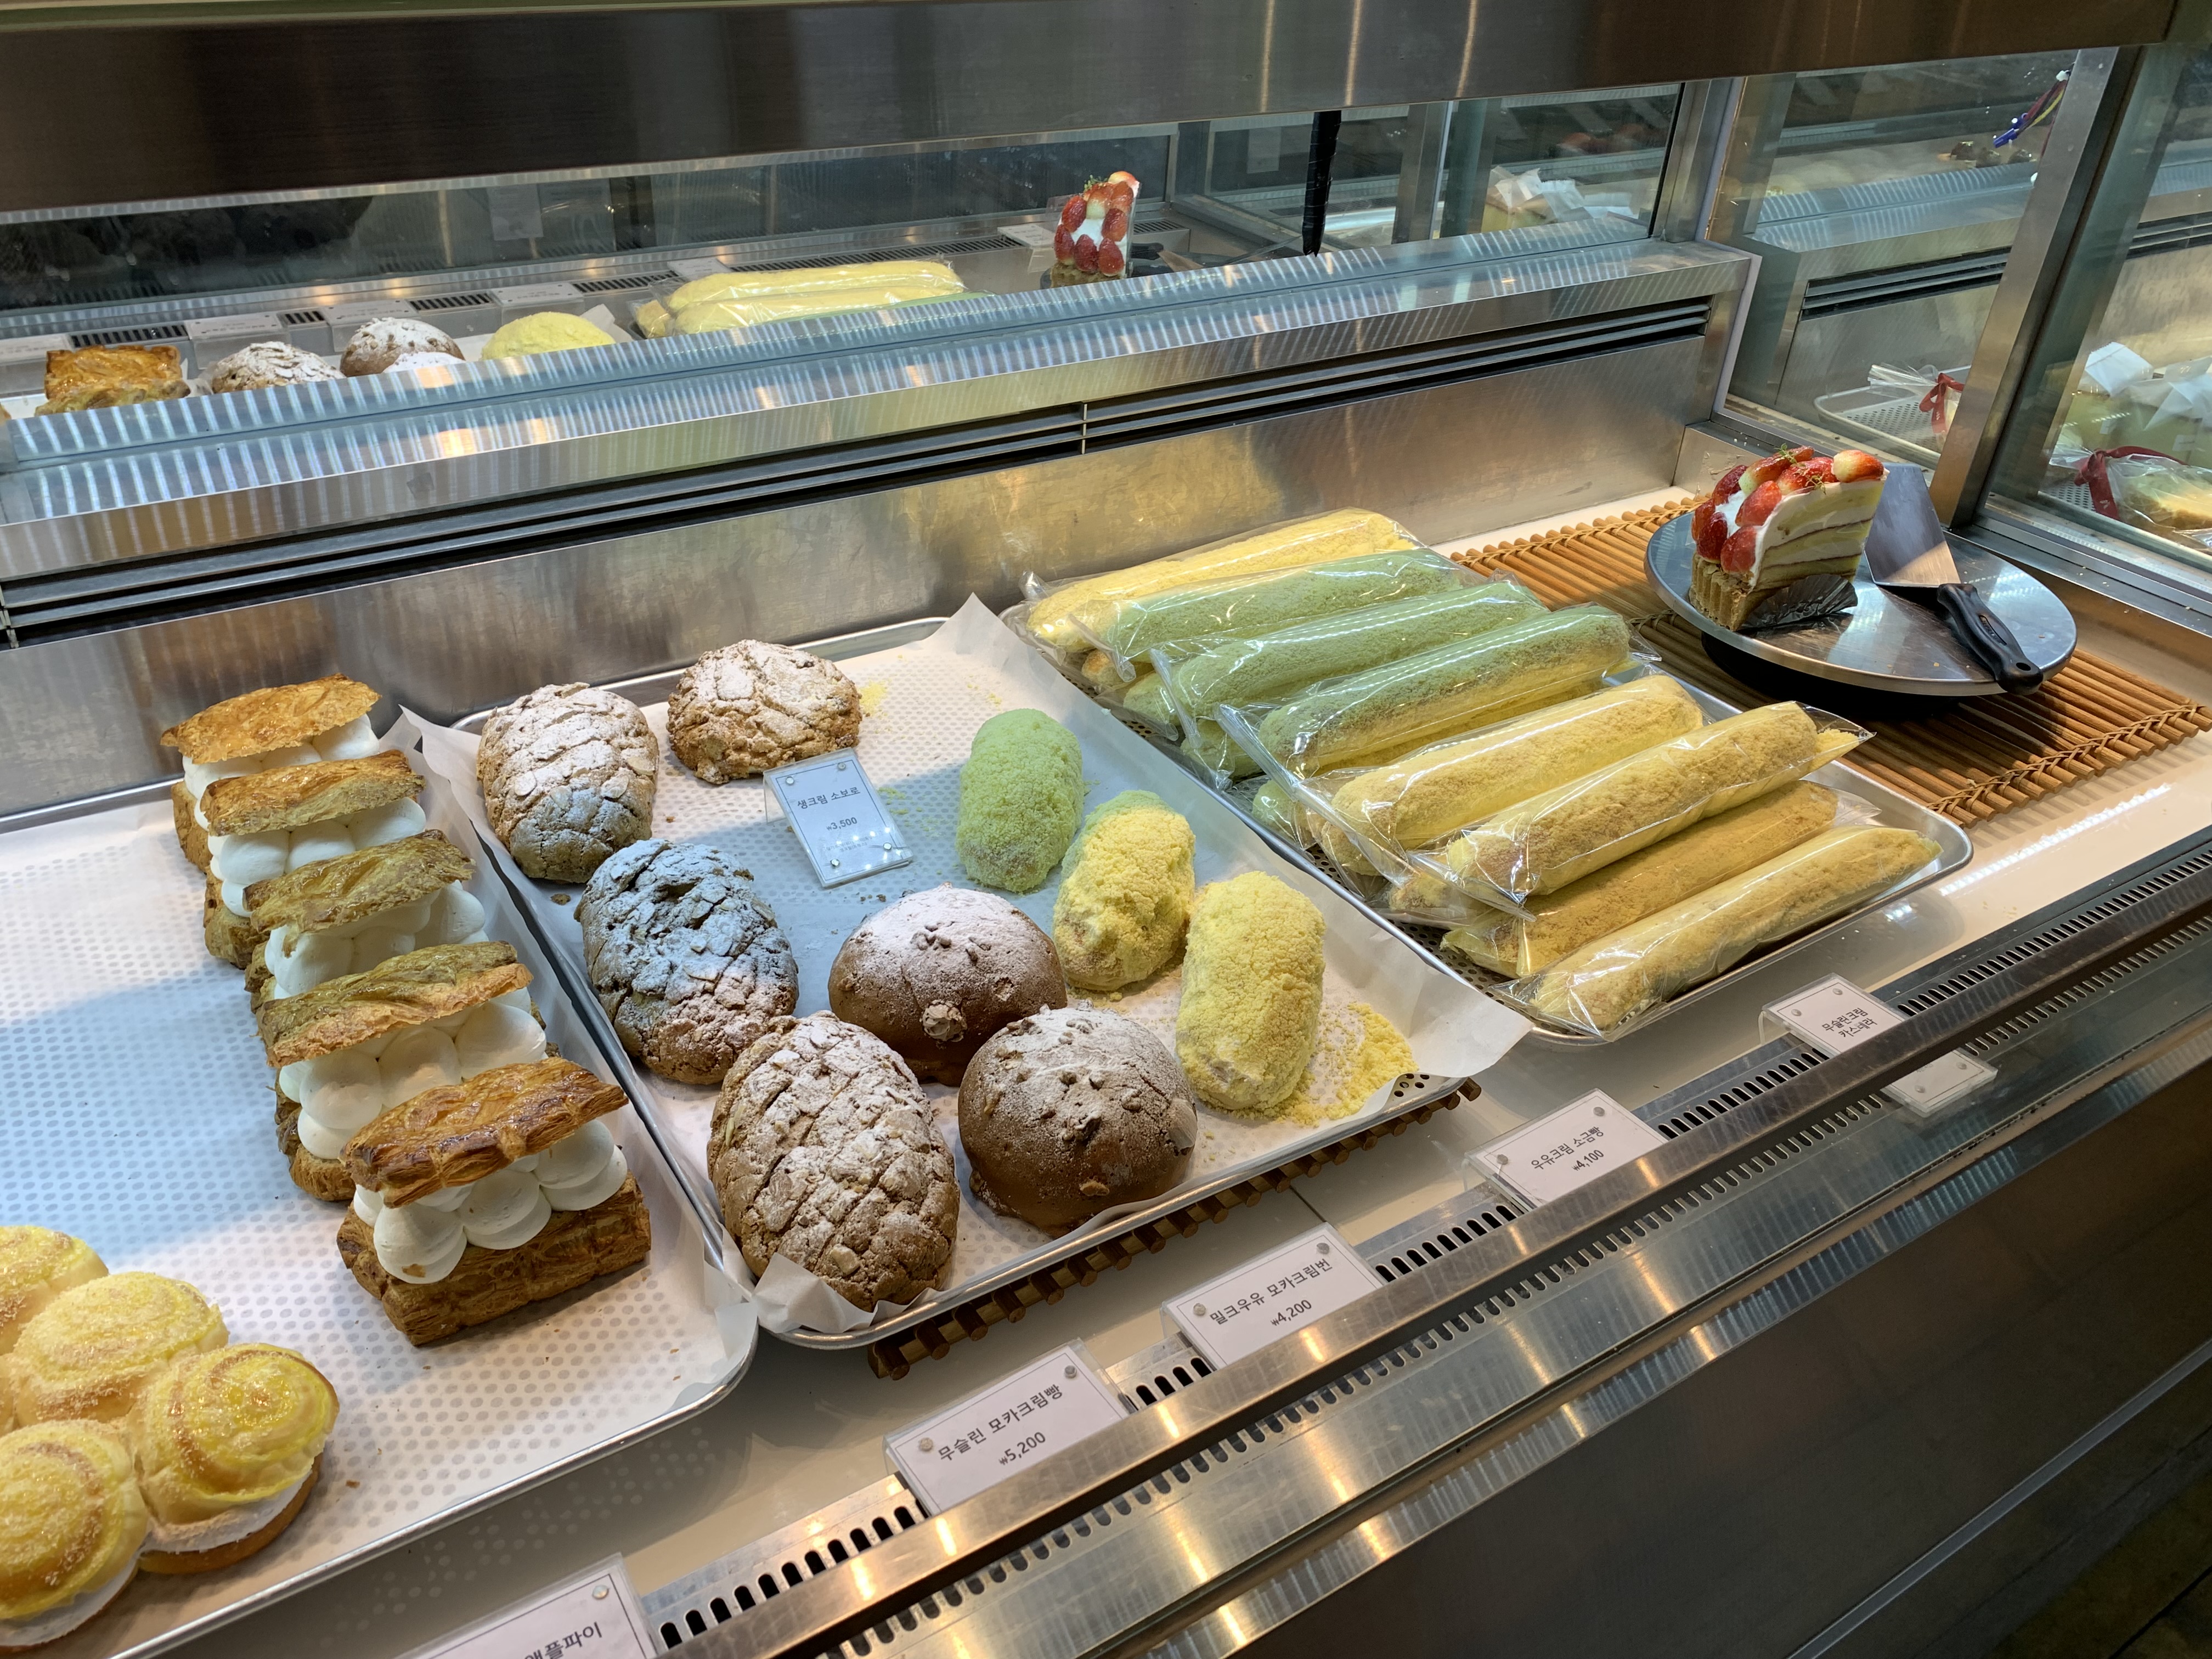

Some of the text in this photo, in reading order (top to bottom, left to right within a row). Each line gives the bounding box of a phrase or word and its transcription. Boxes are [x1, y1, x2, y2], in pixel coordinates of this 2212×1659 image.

[797, 787, 860, 809] 생크림 소보로
[1822, 1008, 1868, 1032] 무슬린크림
[1531, 1126, 1604, 1170] 우유크림 소금빵
[1210, 1259, 1333, 1325] 밀크우유 모카크림번
[938, 1384, 1063, 1461] 무슬린 모카크림빵
